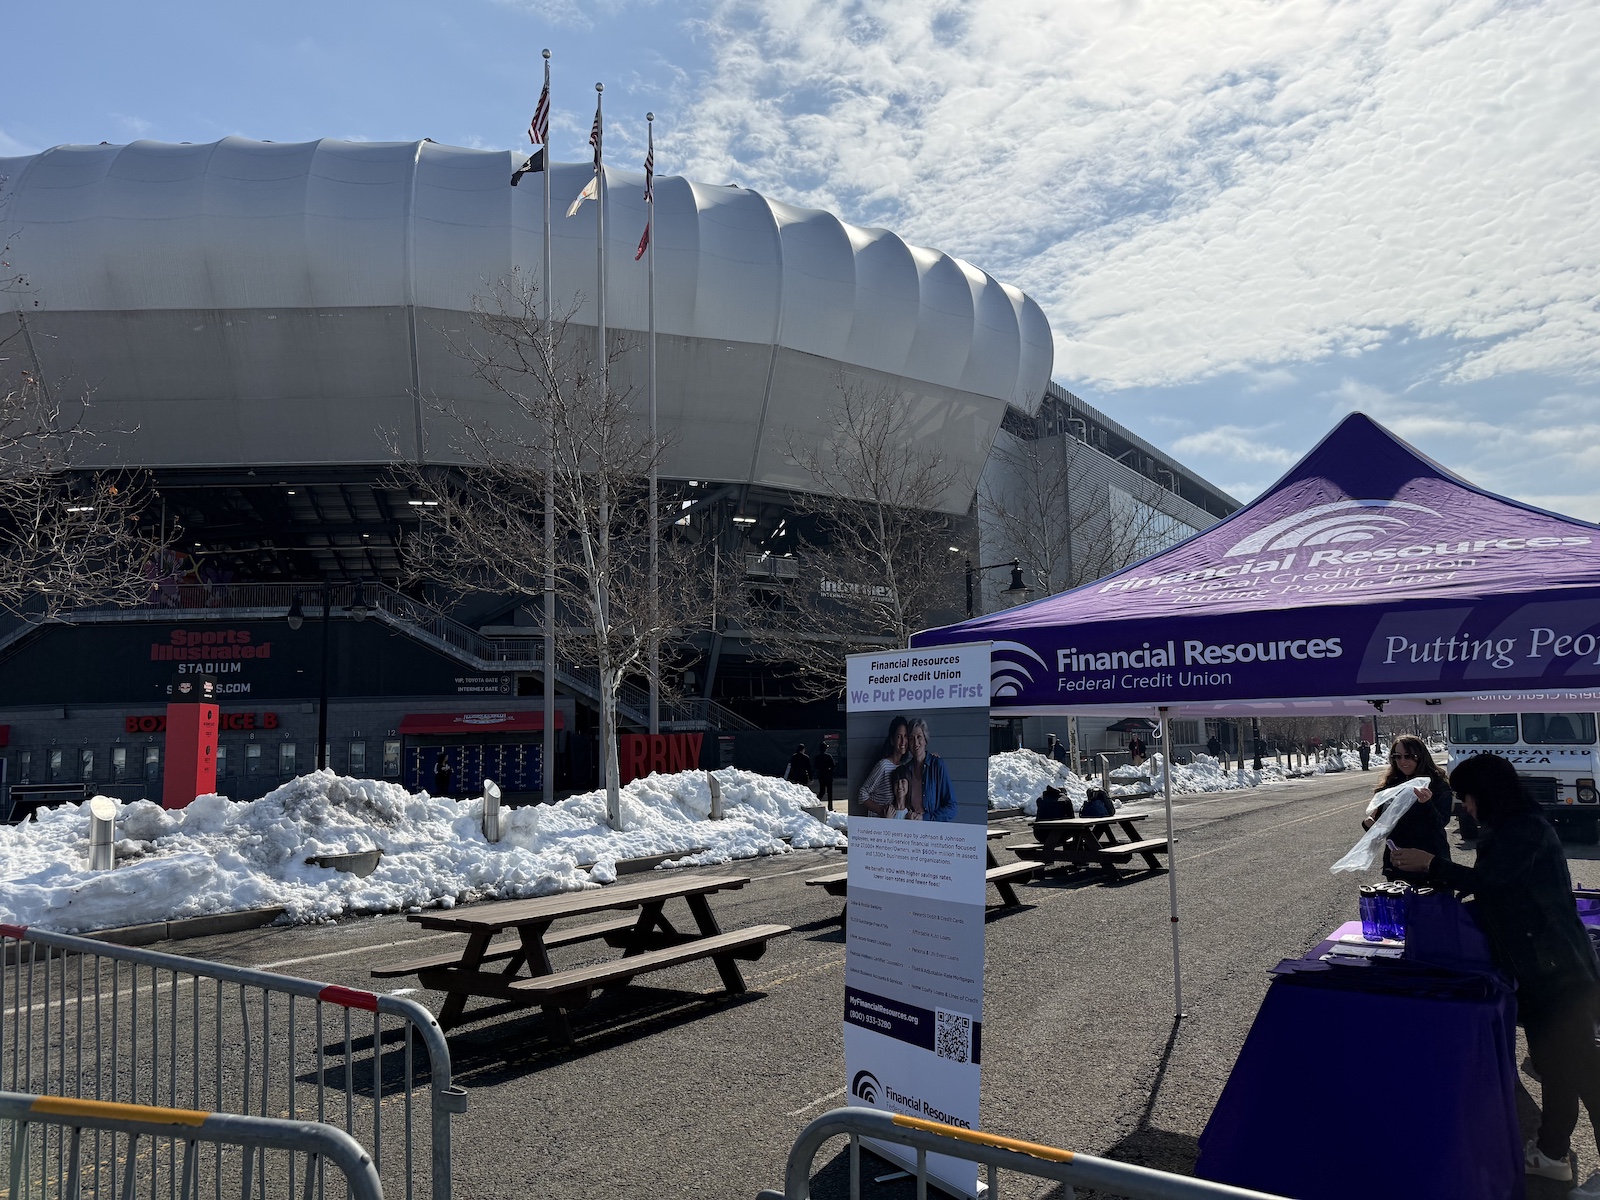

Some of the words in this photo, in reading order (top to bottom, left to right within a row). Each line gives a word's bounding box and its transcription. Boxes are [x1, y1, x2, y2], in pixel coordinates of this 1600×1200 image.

[1098, 553, 1296, 593] Financial
[1308, 536, 1593, 568] Resources
[1155, 576, 1260, 596] Federal
[1270, 567, 1364, 584] Credit
[1377, 558, 1476, 574] Union
[1172, 588, 1271, 604] Putting
[1280, 577, 1374, 595] People
[170, 629, 251, 646] Sports
[151, 642, 271, 661] Illustrated
[1056, 640, 1175, 673] Financial
[1183, 637, 1343, 666] Resources
[1383, 632, 1517, 669] Putting
[178, 662, 241, 674] STADIUM
[871, 658, 910, 671] Financial
[912, 655, 960, 667] Resources
[868, 673, 901, 684] Federal
[902, 671, 931, 682] Credit
[933, 669, 961, 680] Union
[1057, 675, 1115, 692] Federal
[1121, 672, 1173, 689] Credit
[1178, 671, 1232, 687] Union
[851, 690, 869, 704] We
[873, 688, 895, 702] Put
[898, 685, 945, 703] People
[949, 683, 983, 699] First
[263, 712, 278, 729] B
[83, 736, 89, 744] 3
[250, 732, 255, 740] 8
[353, 730, 361, 738] 11
[387, 729, 397, 737] 12
[51, 737, 57, 745] 2
[887, 838, 910, 846] full-service
[931, 842, 954, 850] institution
[886, 852, 910, 861] businesses
[961, 852, 979, 860] assets
[906, 869, 920, 878] higher
[920, 872, 939, 880] savings
[915, 878, 928, 886] fewer
[953, 974, 975, 983] Mortgages
[933, 989, 944, 997] Loans
[965, 996, 978, 1004] Credit
[849, 995, 919, 1026] MyFinancialResources.org
[849, 1010, 865, 1022] (800)
[886, 1085, 921, 1112] Financial
[923, 1101, 971, 1130] Resources
